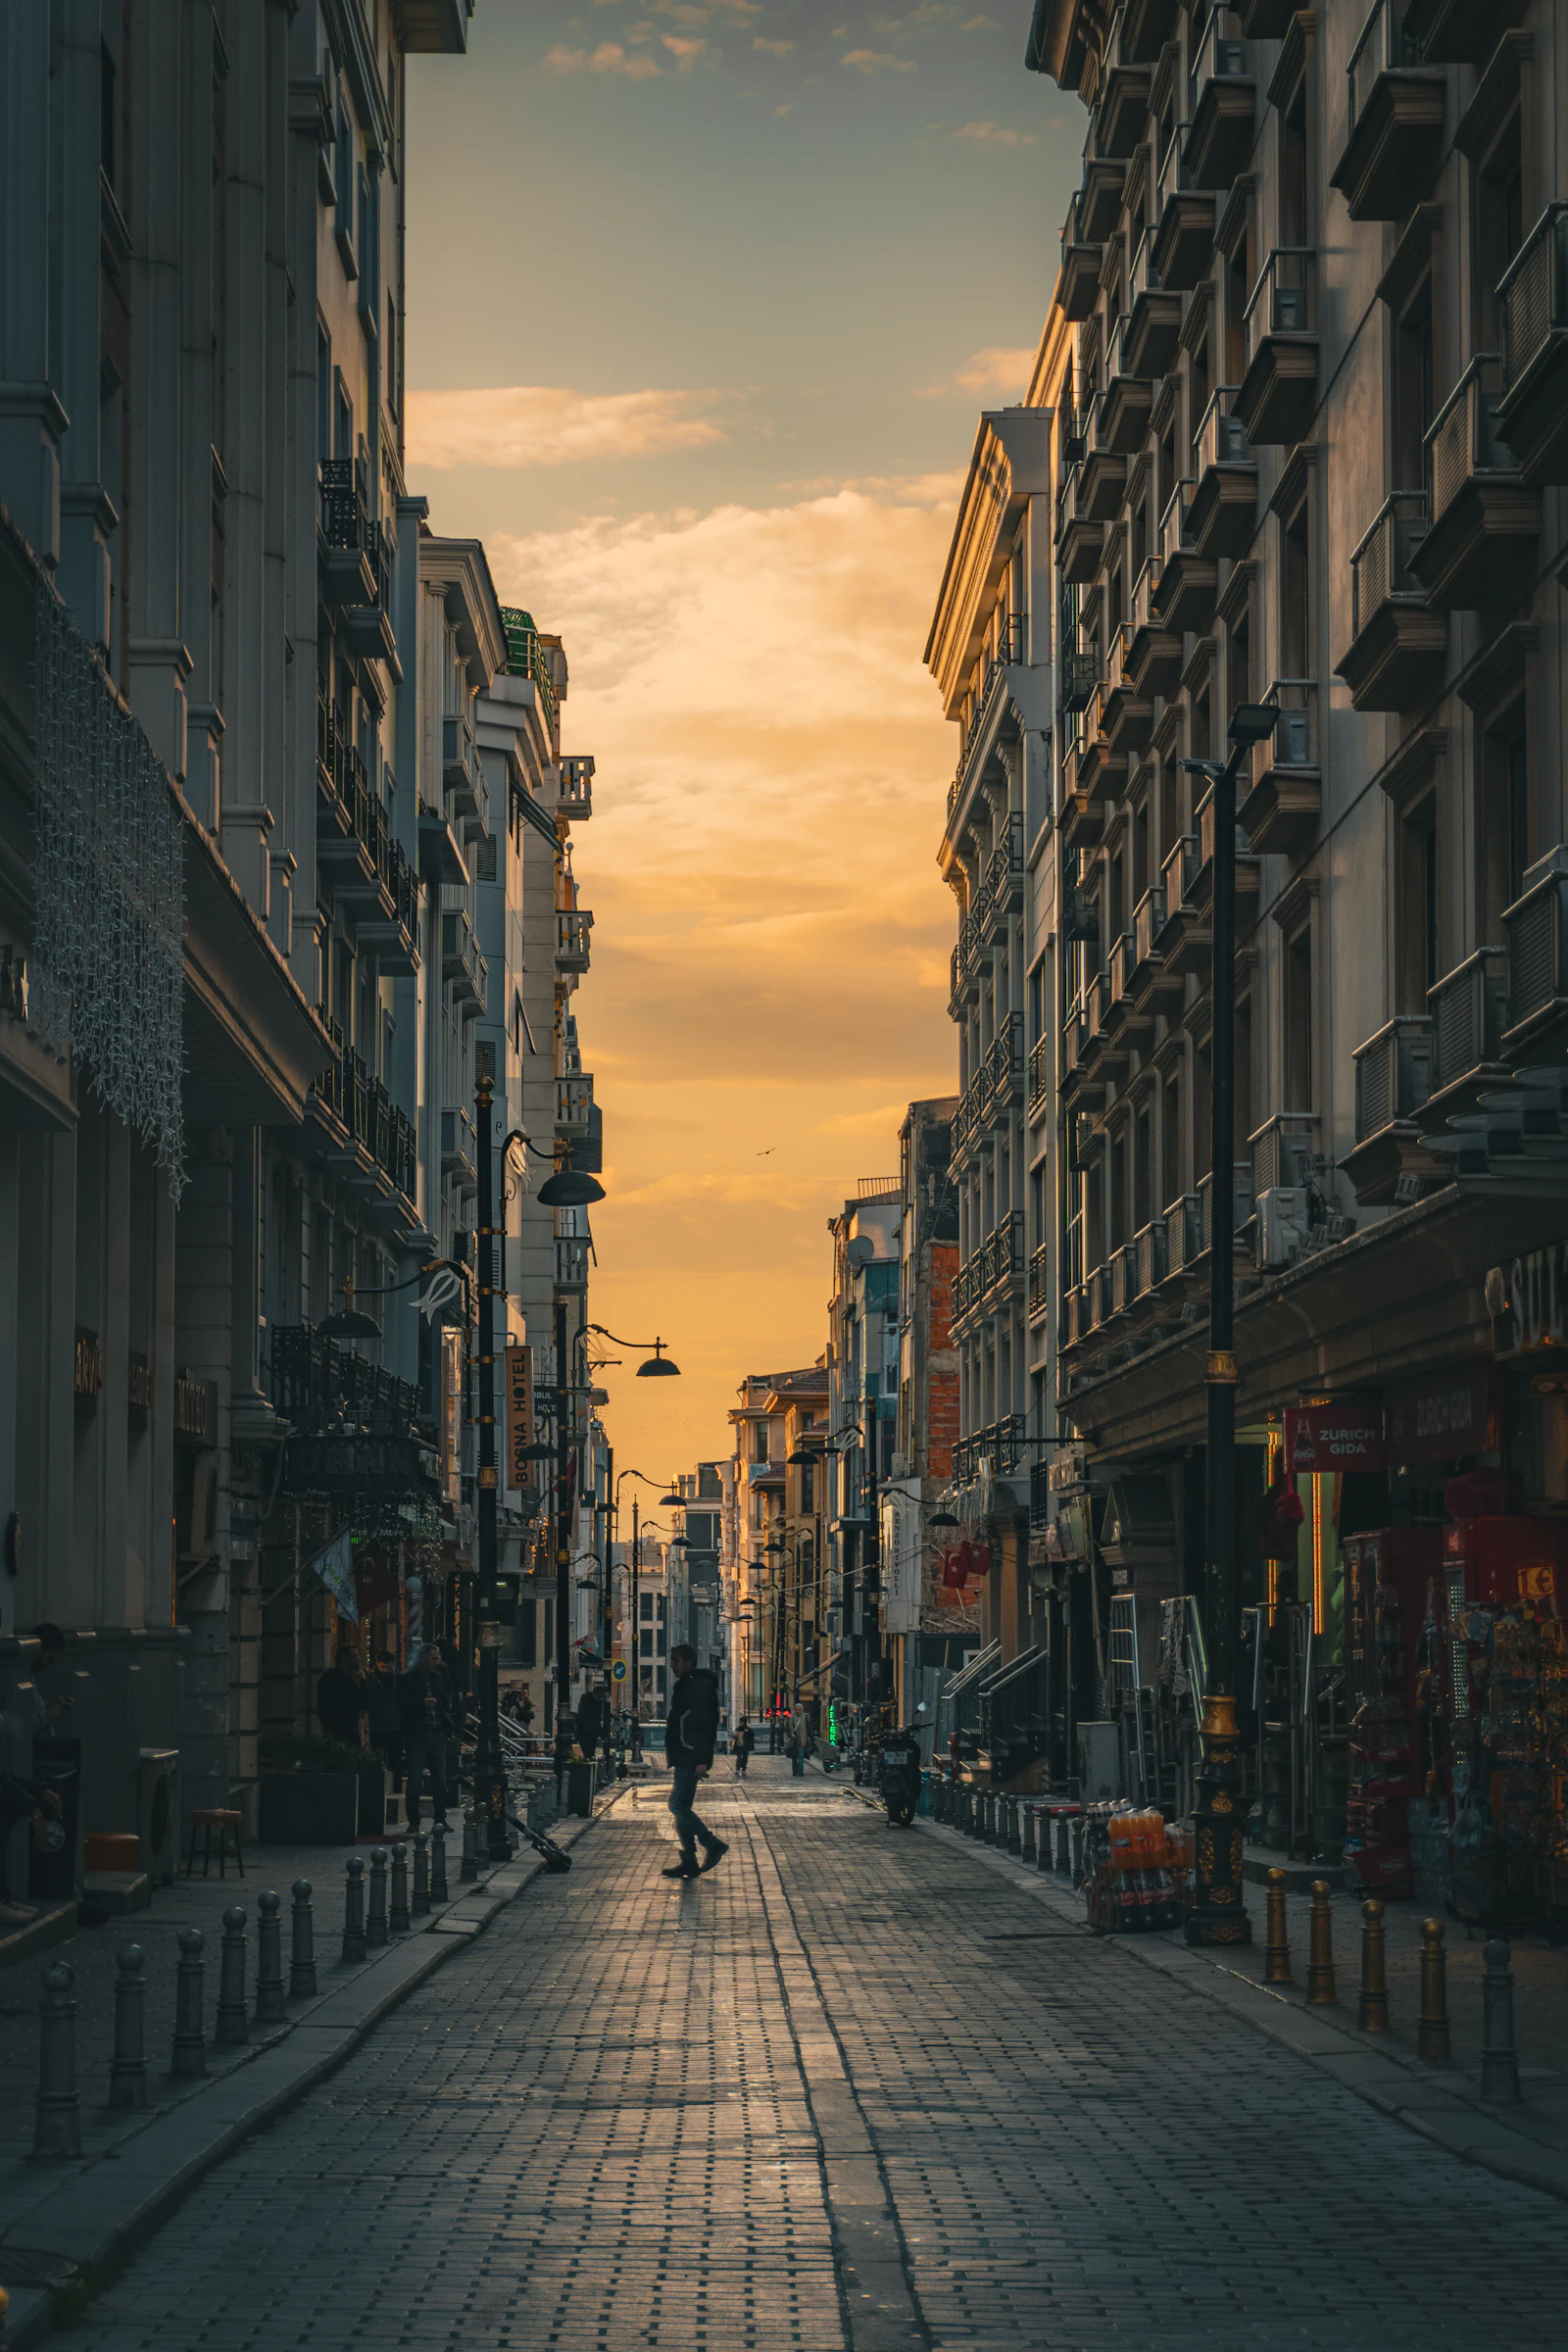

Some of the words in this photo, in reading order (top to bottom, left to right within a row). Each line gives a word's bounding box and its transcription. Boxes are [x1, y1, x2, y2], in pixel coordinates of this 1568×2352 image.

[513, 1353, 526, 1412] HOTEL
[1319, 1429, 1375, 1441] ZURICH
[1330, 1443, 1366, 1454] GIDA
